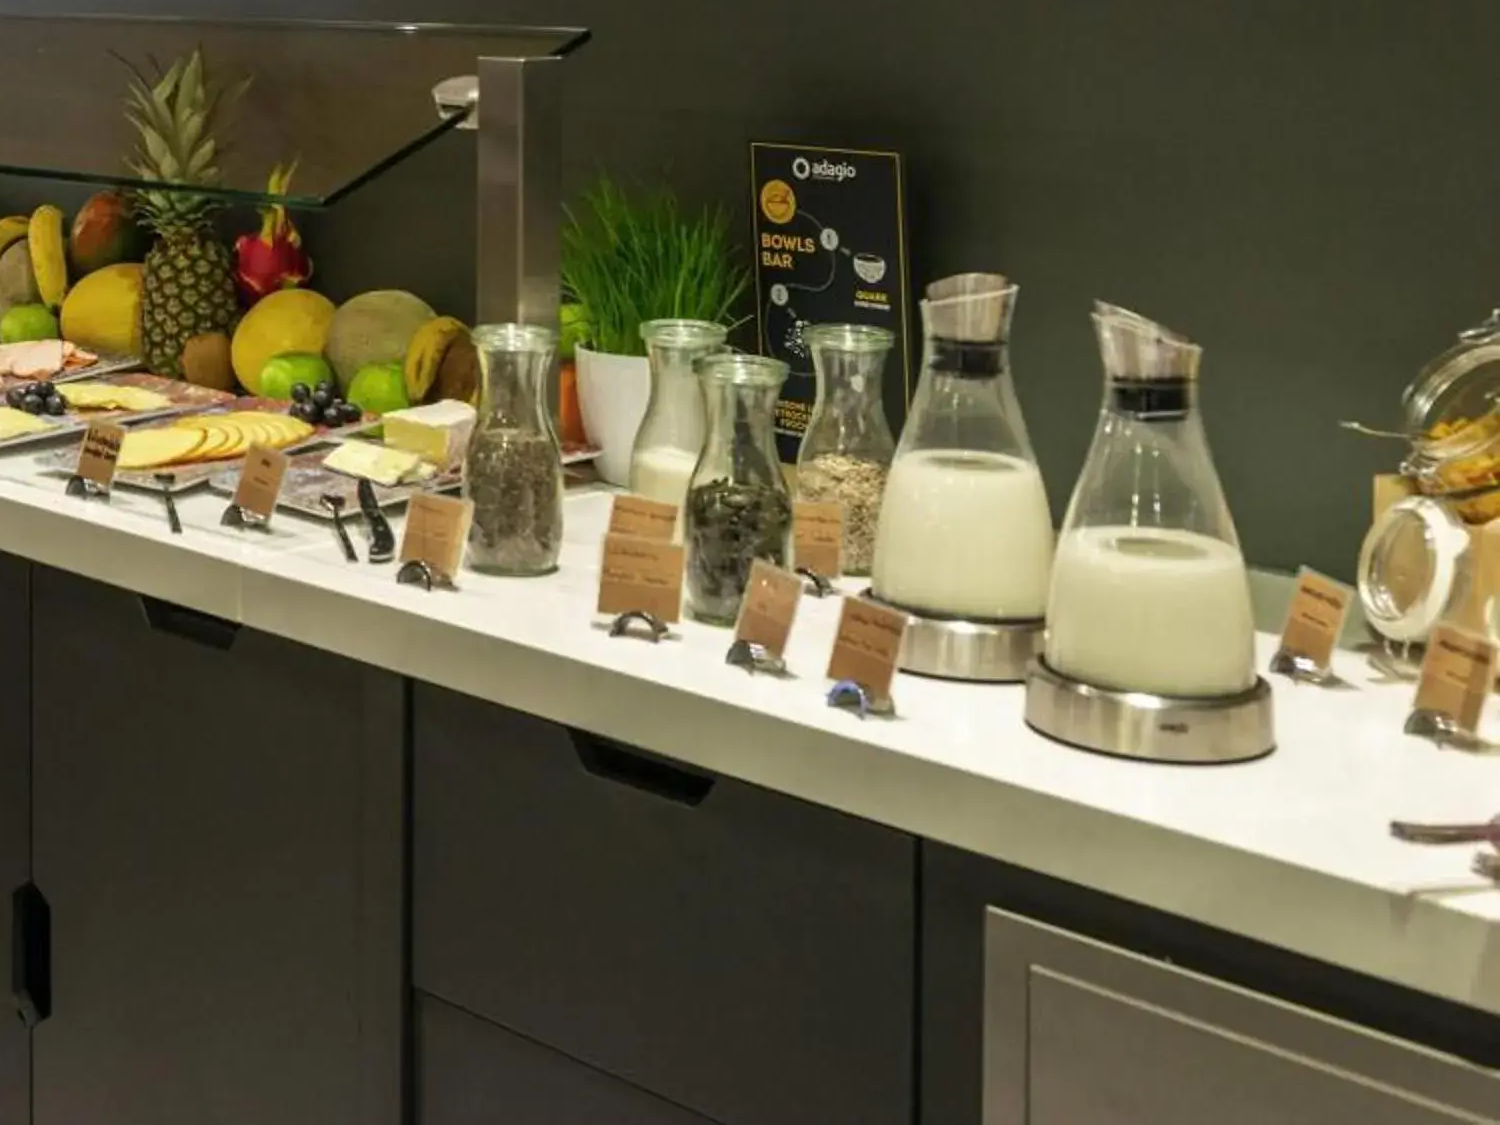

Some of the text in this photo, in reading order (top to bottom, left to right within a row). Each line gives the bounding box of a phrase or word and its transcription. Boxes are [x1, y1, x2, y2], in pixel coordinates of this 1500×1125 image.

[811, 159, 856, 181] adagio
[761, 232, 816, 253] BOWLS
[762, 251, 793, 270] BAR
